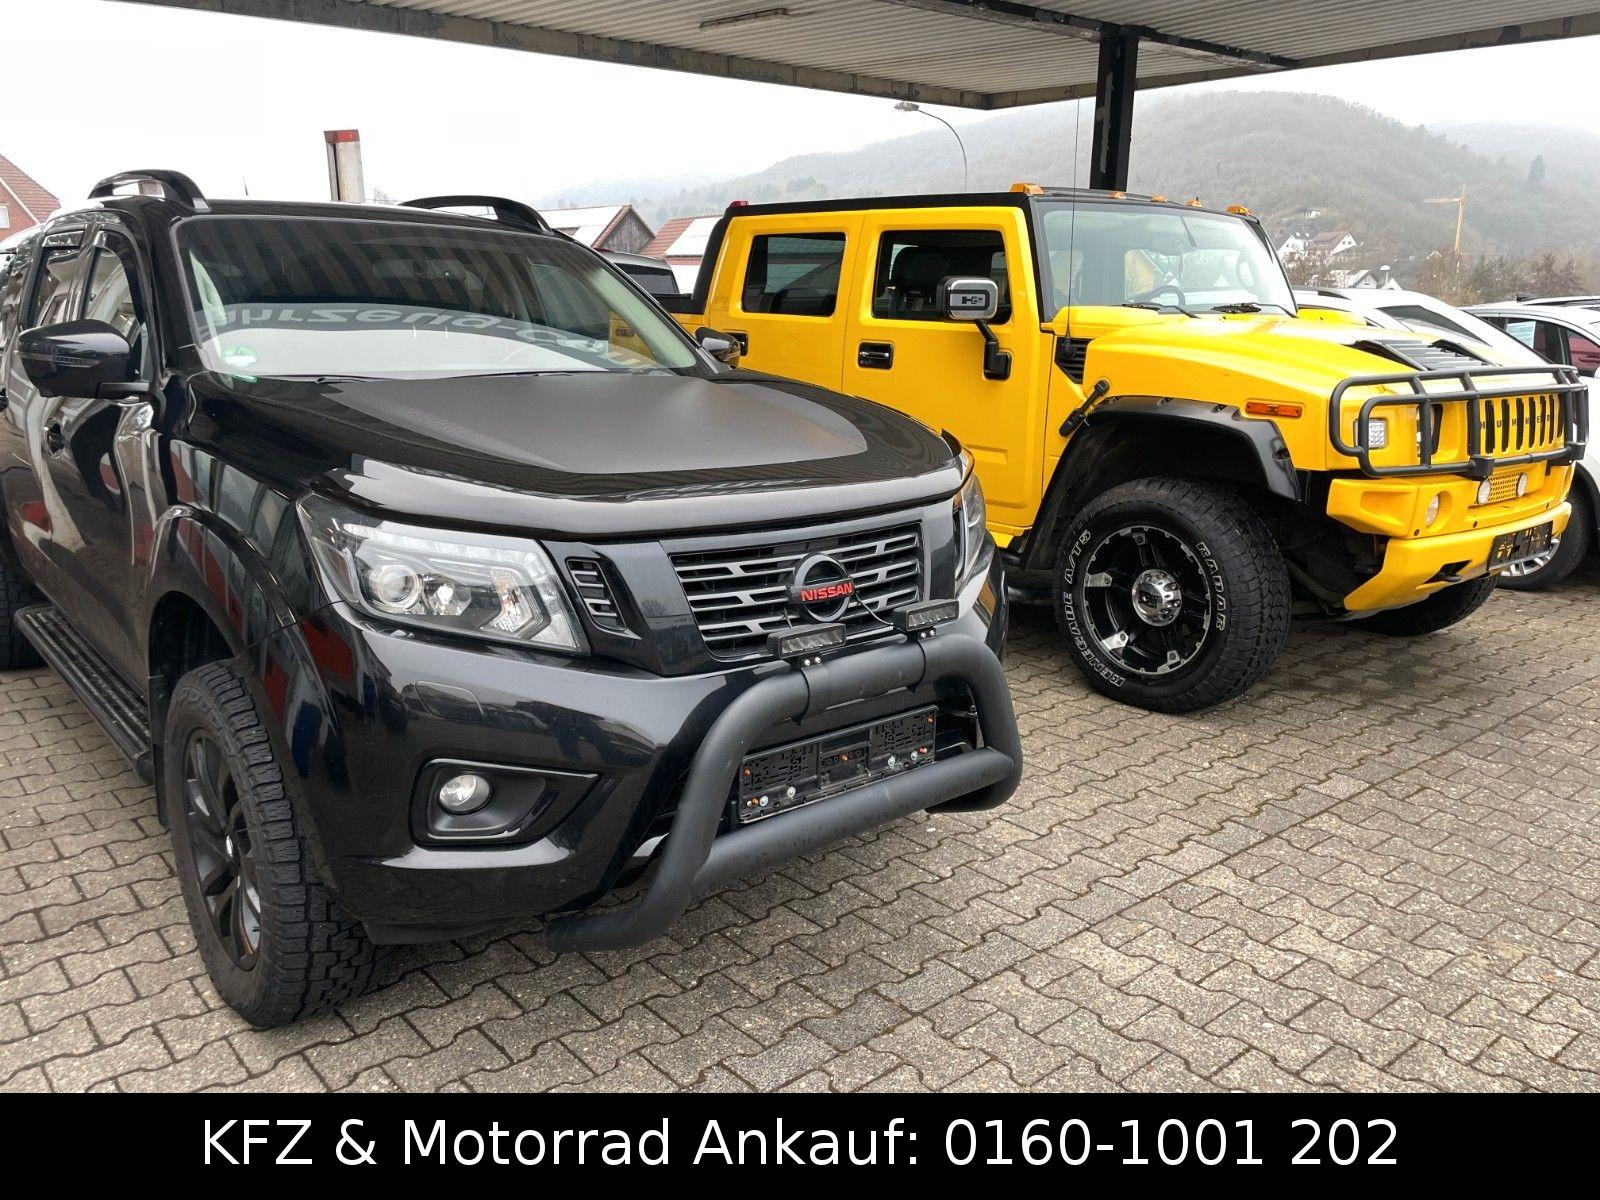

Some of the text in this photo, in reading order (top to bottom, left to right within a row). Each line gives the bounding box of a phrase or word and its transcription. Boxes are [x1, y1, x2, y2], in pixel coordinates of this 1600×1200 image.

[800, 583, 854, 603] NISSAN
[1195, 541, 1227, 631] RADAR
[1063, 591, 1126, 687] RENEGADE
